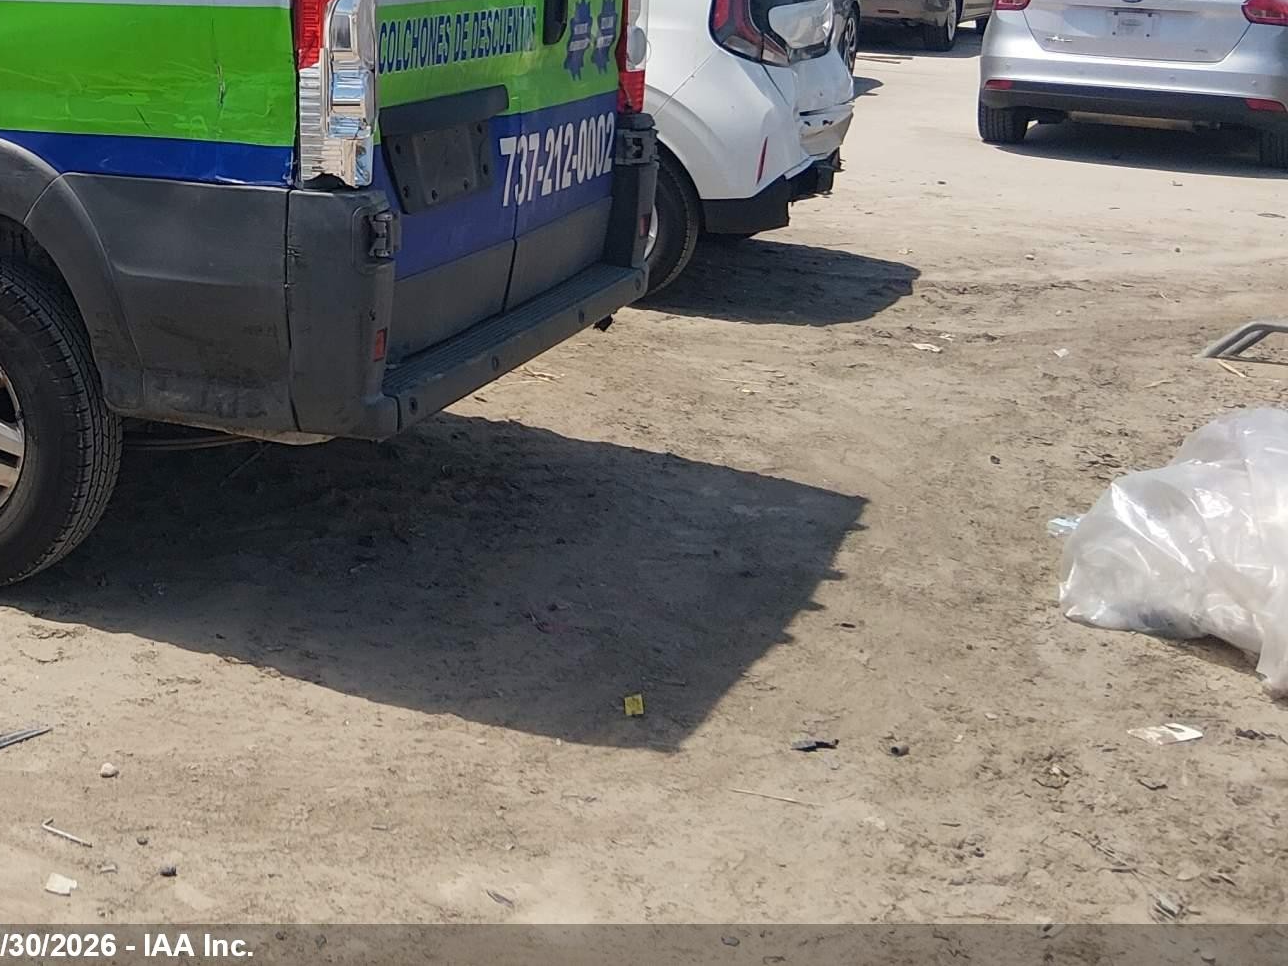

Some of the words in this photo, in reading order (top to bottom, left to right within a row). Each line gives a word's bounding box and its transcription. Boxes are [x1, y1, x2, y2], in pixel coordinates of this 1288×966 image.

[378, 14, 451, 75] COLCHONES
[453, 11, 470, 63] DE
[470, 4, 538, 60] DESCUENTOS
[499, 112, 615, 207] 737-212-0002
